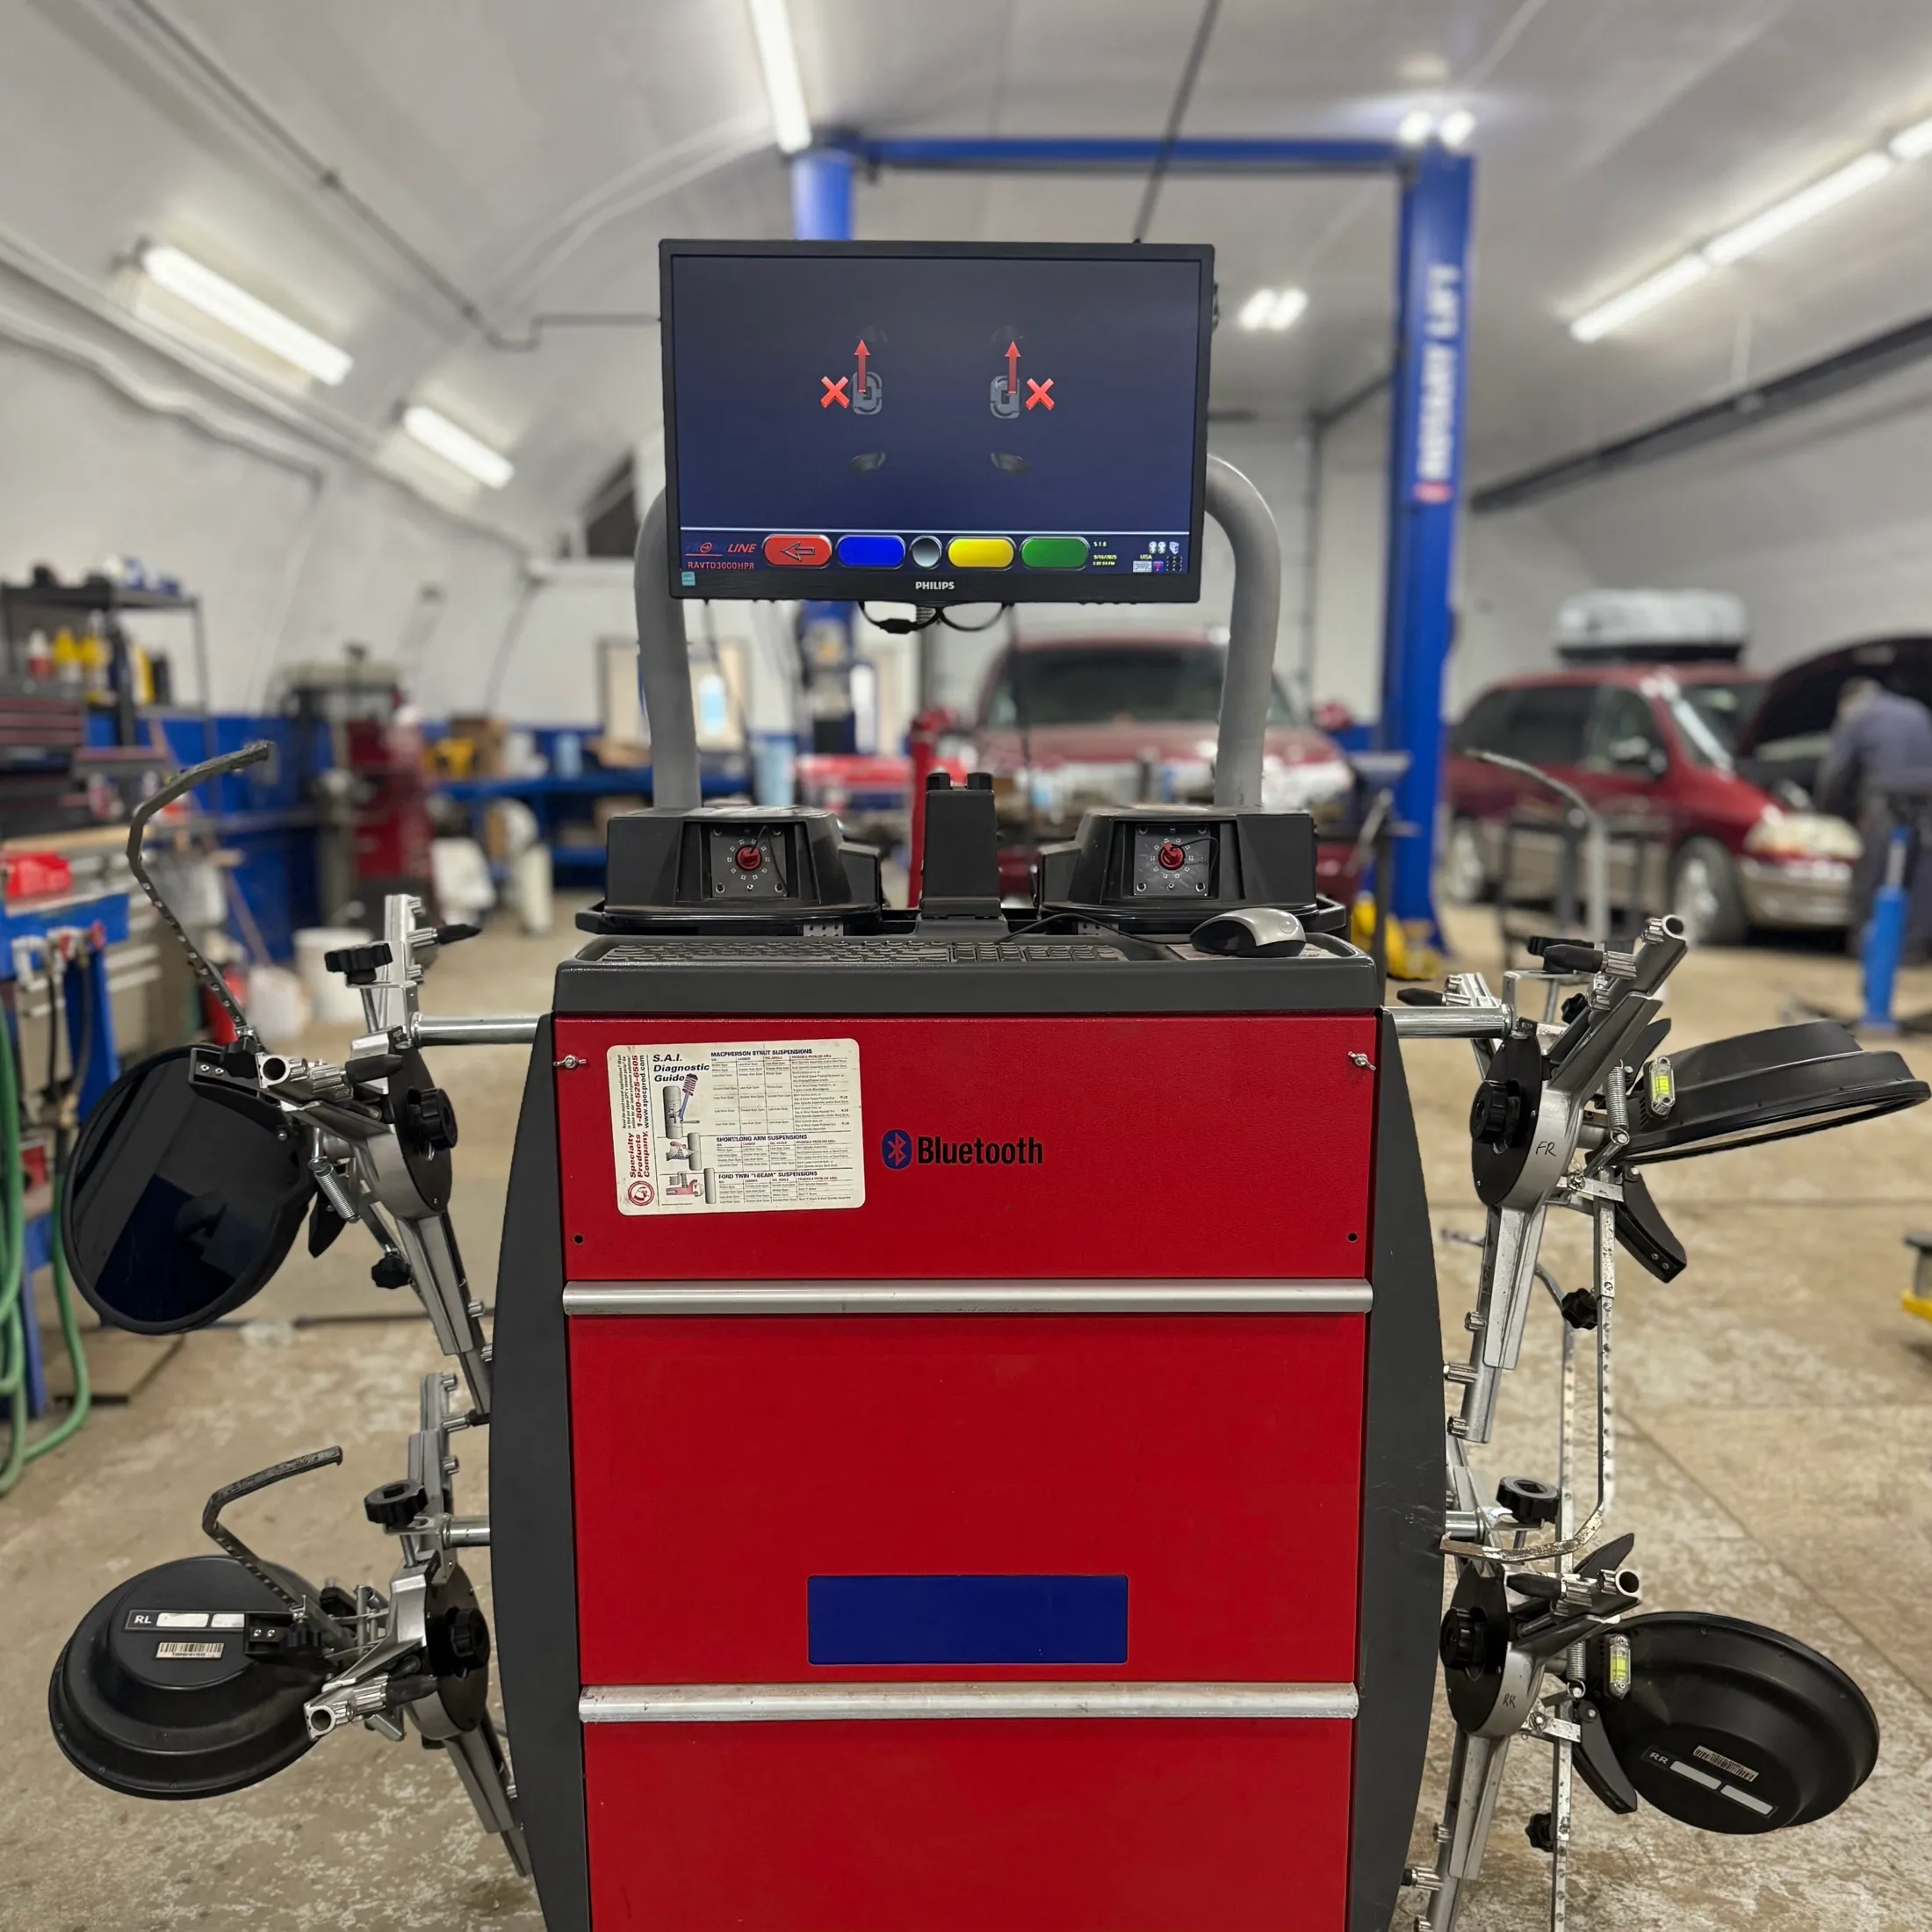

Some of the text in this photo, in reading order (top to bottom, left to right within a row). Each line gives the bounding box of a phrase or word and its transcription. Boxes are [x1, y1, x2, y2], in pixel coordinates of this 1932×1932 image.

[727, 544, 756, 553] LINE
[915, 580, 955, 590] PHILIPS
[652, 1053, 682, 1062] S.A.I.
[653, 1063, 710, 1073] Diagnostic
[654, 1073, 685, 1082] Guide
[632, 1055, 643, 1127] 1-800-525-6505
[639, 1055, 649, 1128] www.specprod.com
[628, 1133, 637, 1178] Specialty
[918, 1136, 1043, 1164] Bluetooth
[1535, 1141, 1557, 1157] FR
[134, 1615, 152, 1624] RL
[1502, 1693, 1517, 1709] RR
[1649, 1751, 1669, 1764] RR
